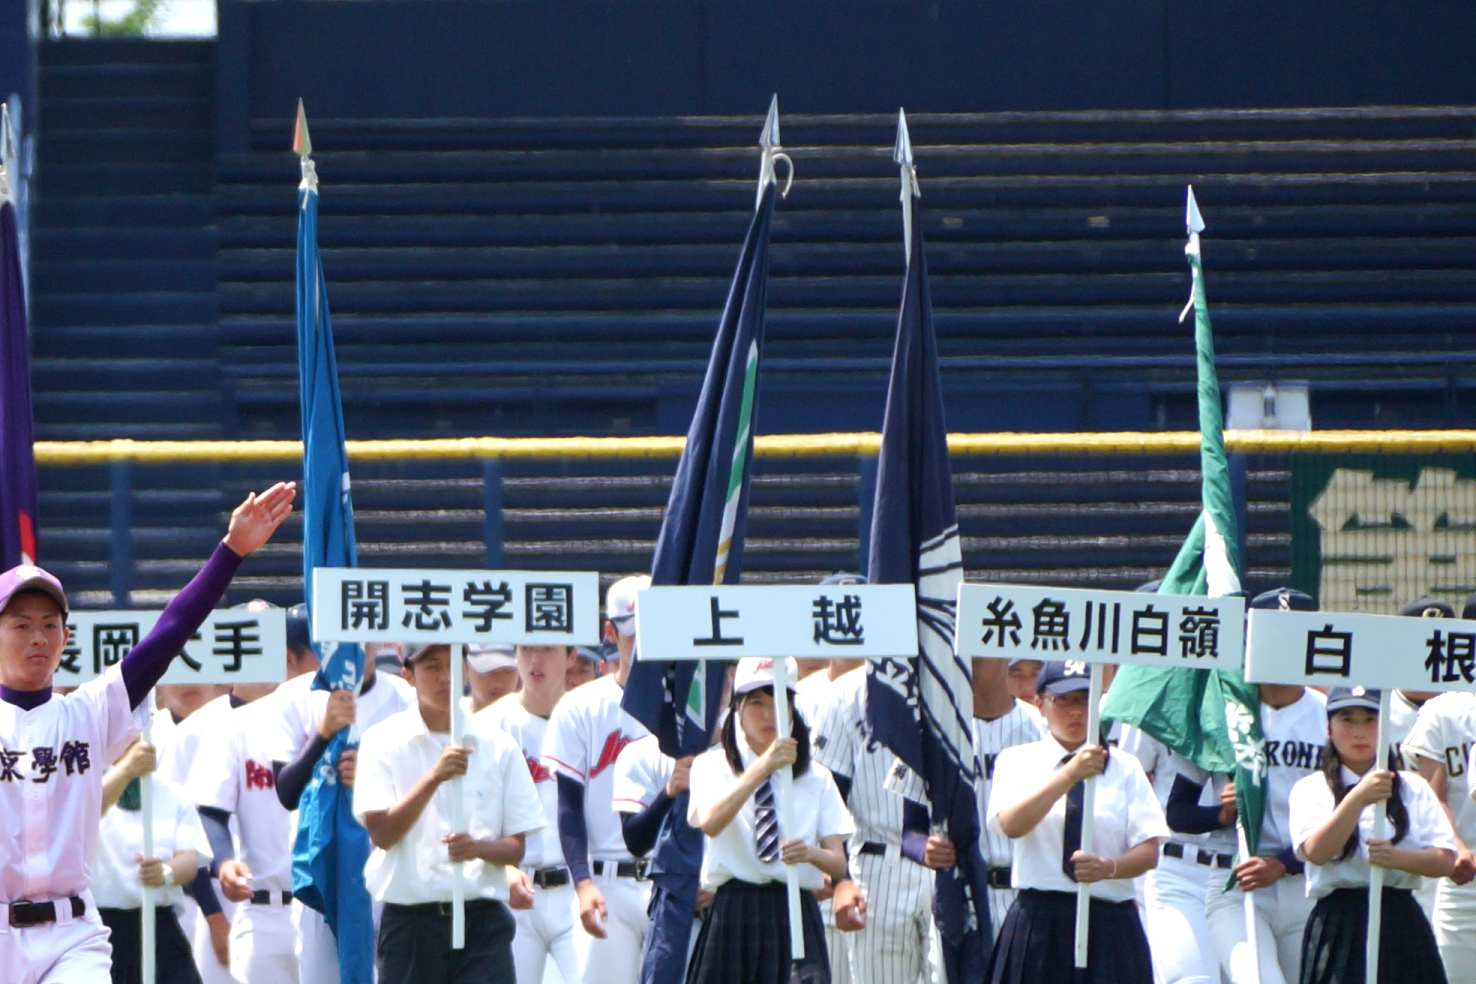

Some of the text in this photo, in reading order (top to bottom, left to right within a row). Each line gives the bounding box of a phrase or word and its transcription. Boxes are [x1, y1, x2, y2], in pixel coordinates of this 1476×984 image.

[341, 579, 573, 633] 開志学園
[693, 594, 865, 646] 上越
[981, 595, 1221, 659] 糸魚川白嶺
[1305, 623, 1476, 684] 白根
